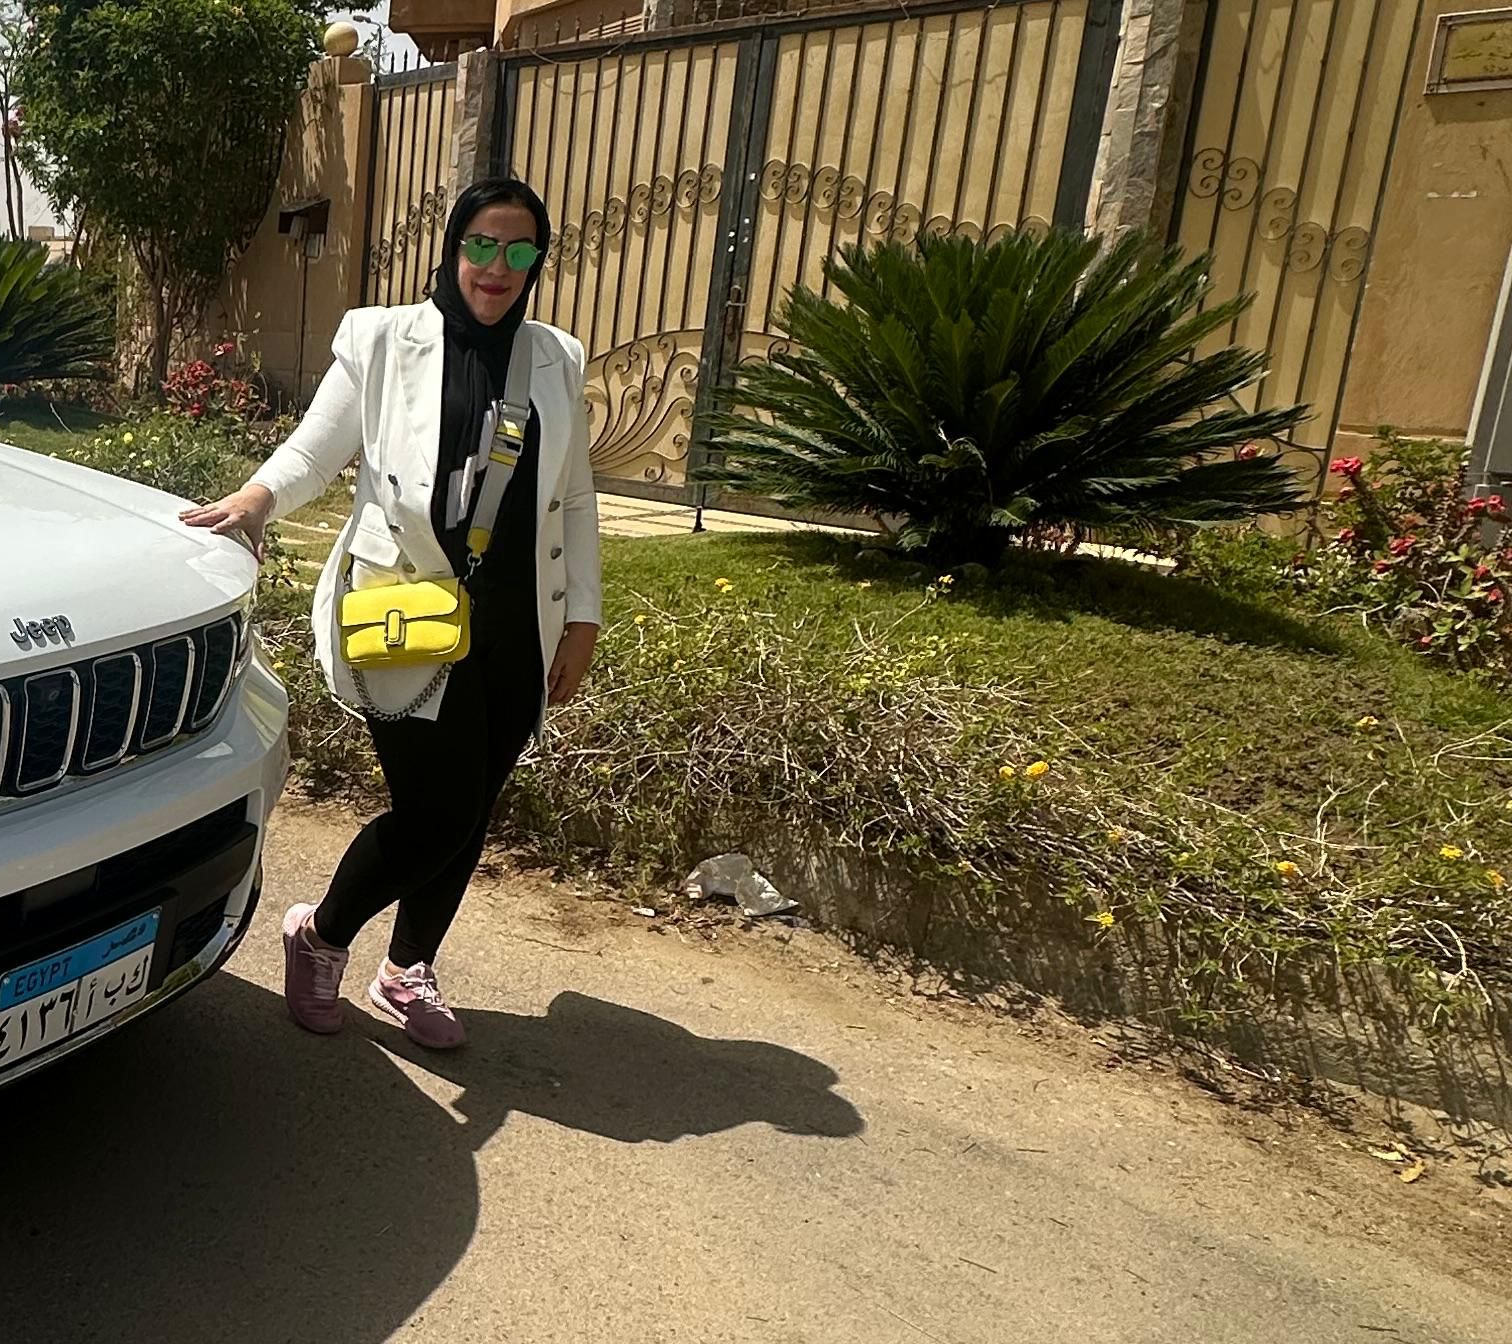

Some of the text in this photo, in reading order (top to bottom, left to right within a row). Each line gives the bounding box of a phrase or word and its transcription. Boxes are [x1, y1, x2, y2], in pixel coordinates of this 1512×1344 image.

[9, 615, 74, 649] Jeep
[101, 922, 147, 960] مصر
[14, 956, 73, 998] EGYPT
